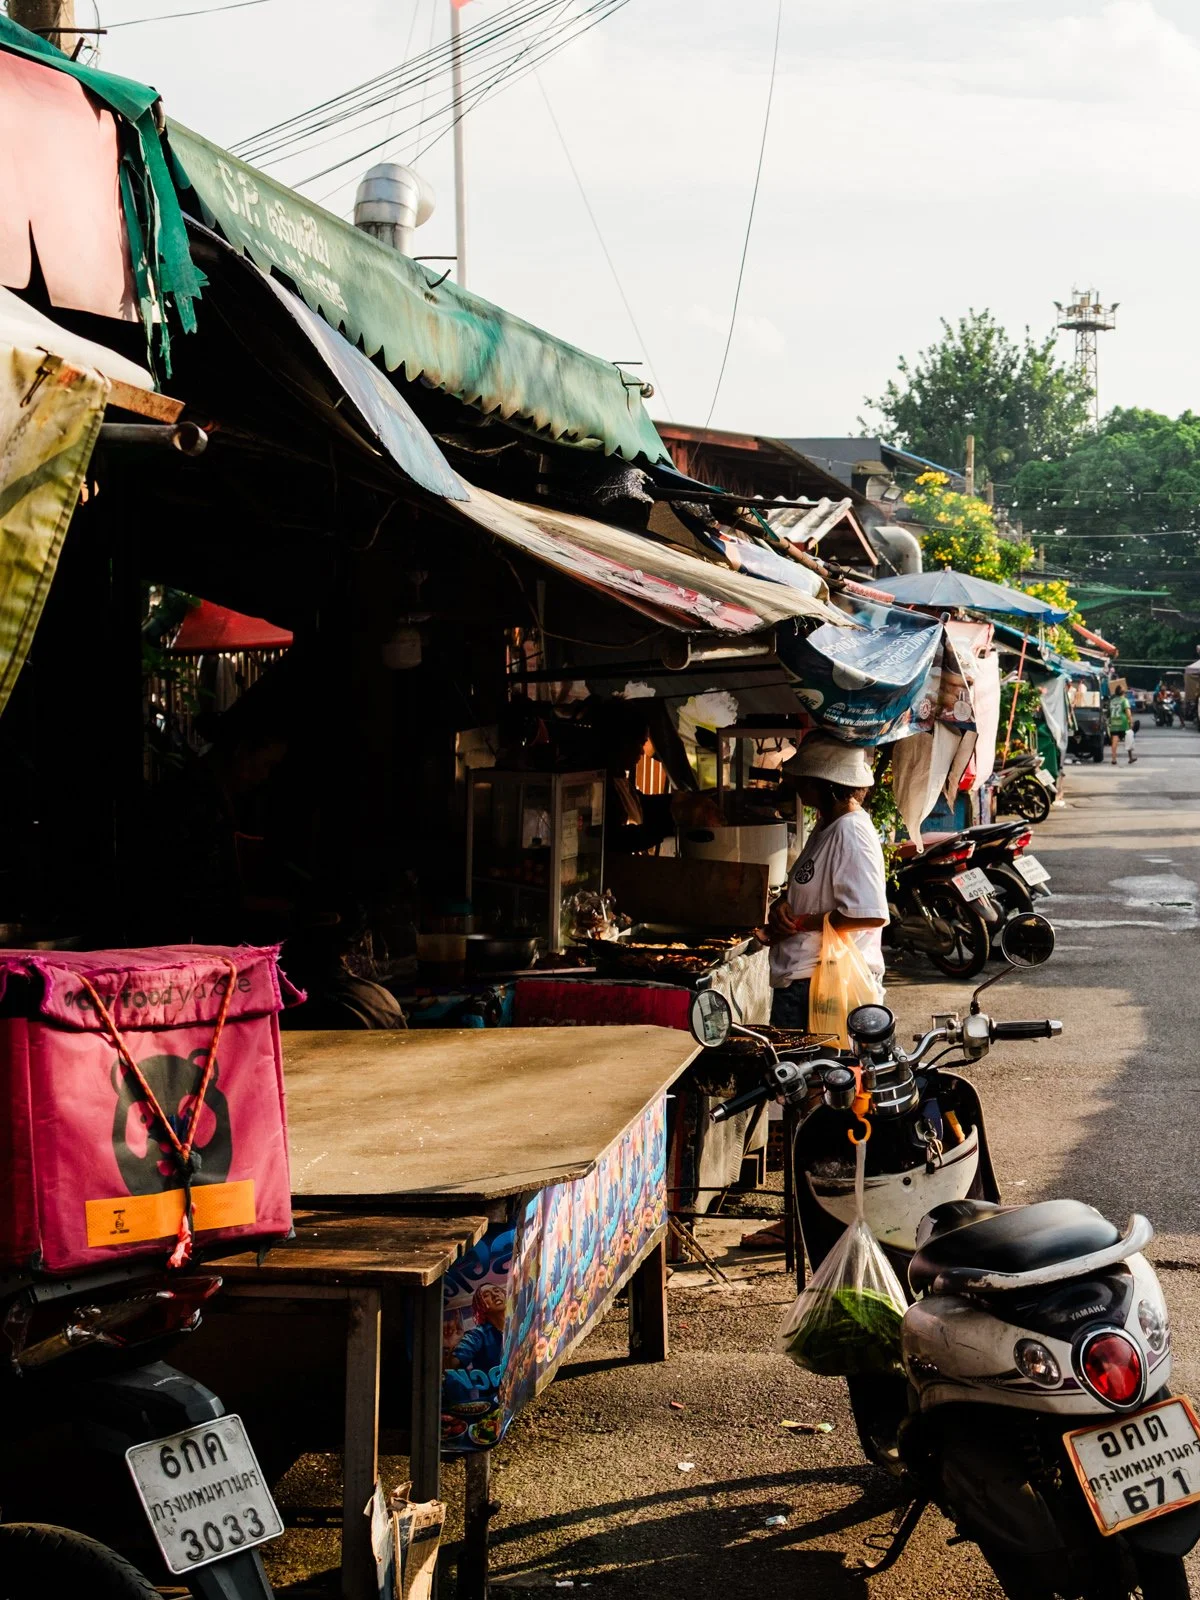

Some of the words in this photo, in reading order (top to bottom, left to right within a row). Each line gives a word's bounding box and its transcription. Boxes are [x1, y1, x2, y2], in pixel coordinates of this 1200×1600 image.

[968, 886, 988, 898] 4051
[1069, 1304, 1107, 1321] YAMAHA
[160, 1431, 229, 1479] 6กค
[1097, 1414, 1169, 1458] อคต
[151, 1470, 260, 1523] กรุงเทพมหานคร
[1122, 1469, 1191, 1515] 671
[180, 1507, 266, 1562] 3033
